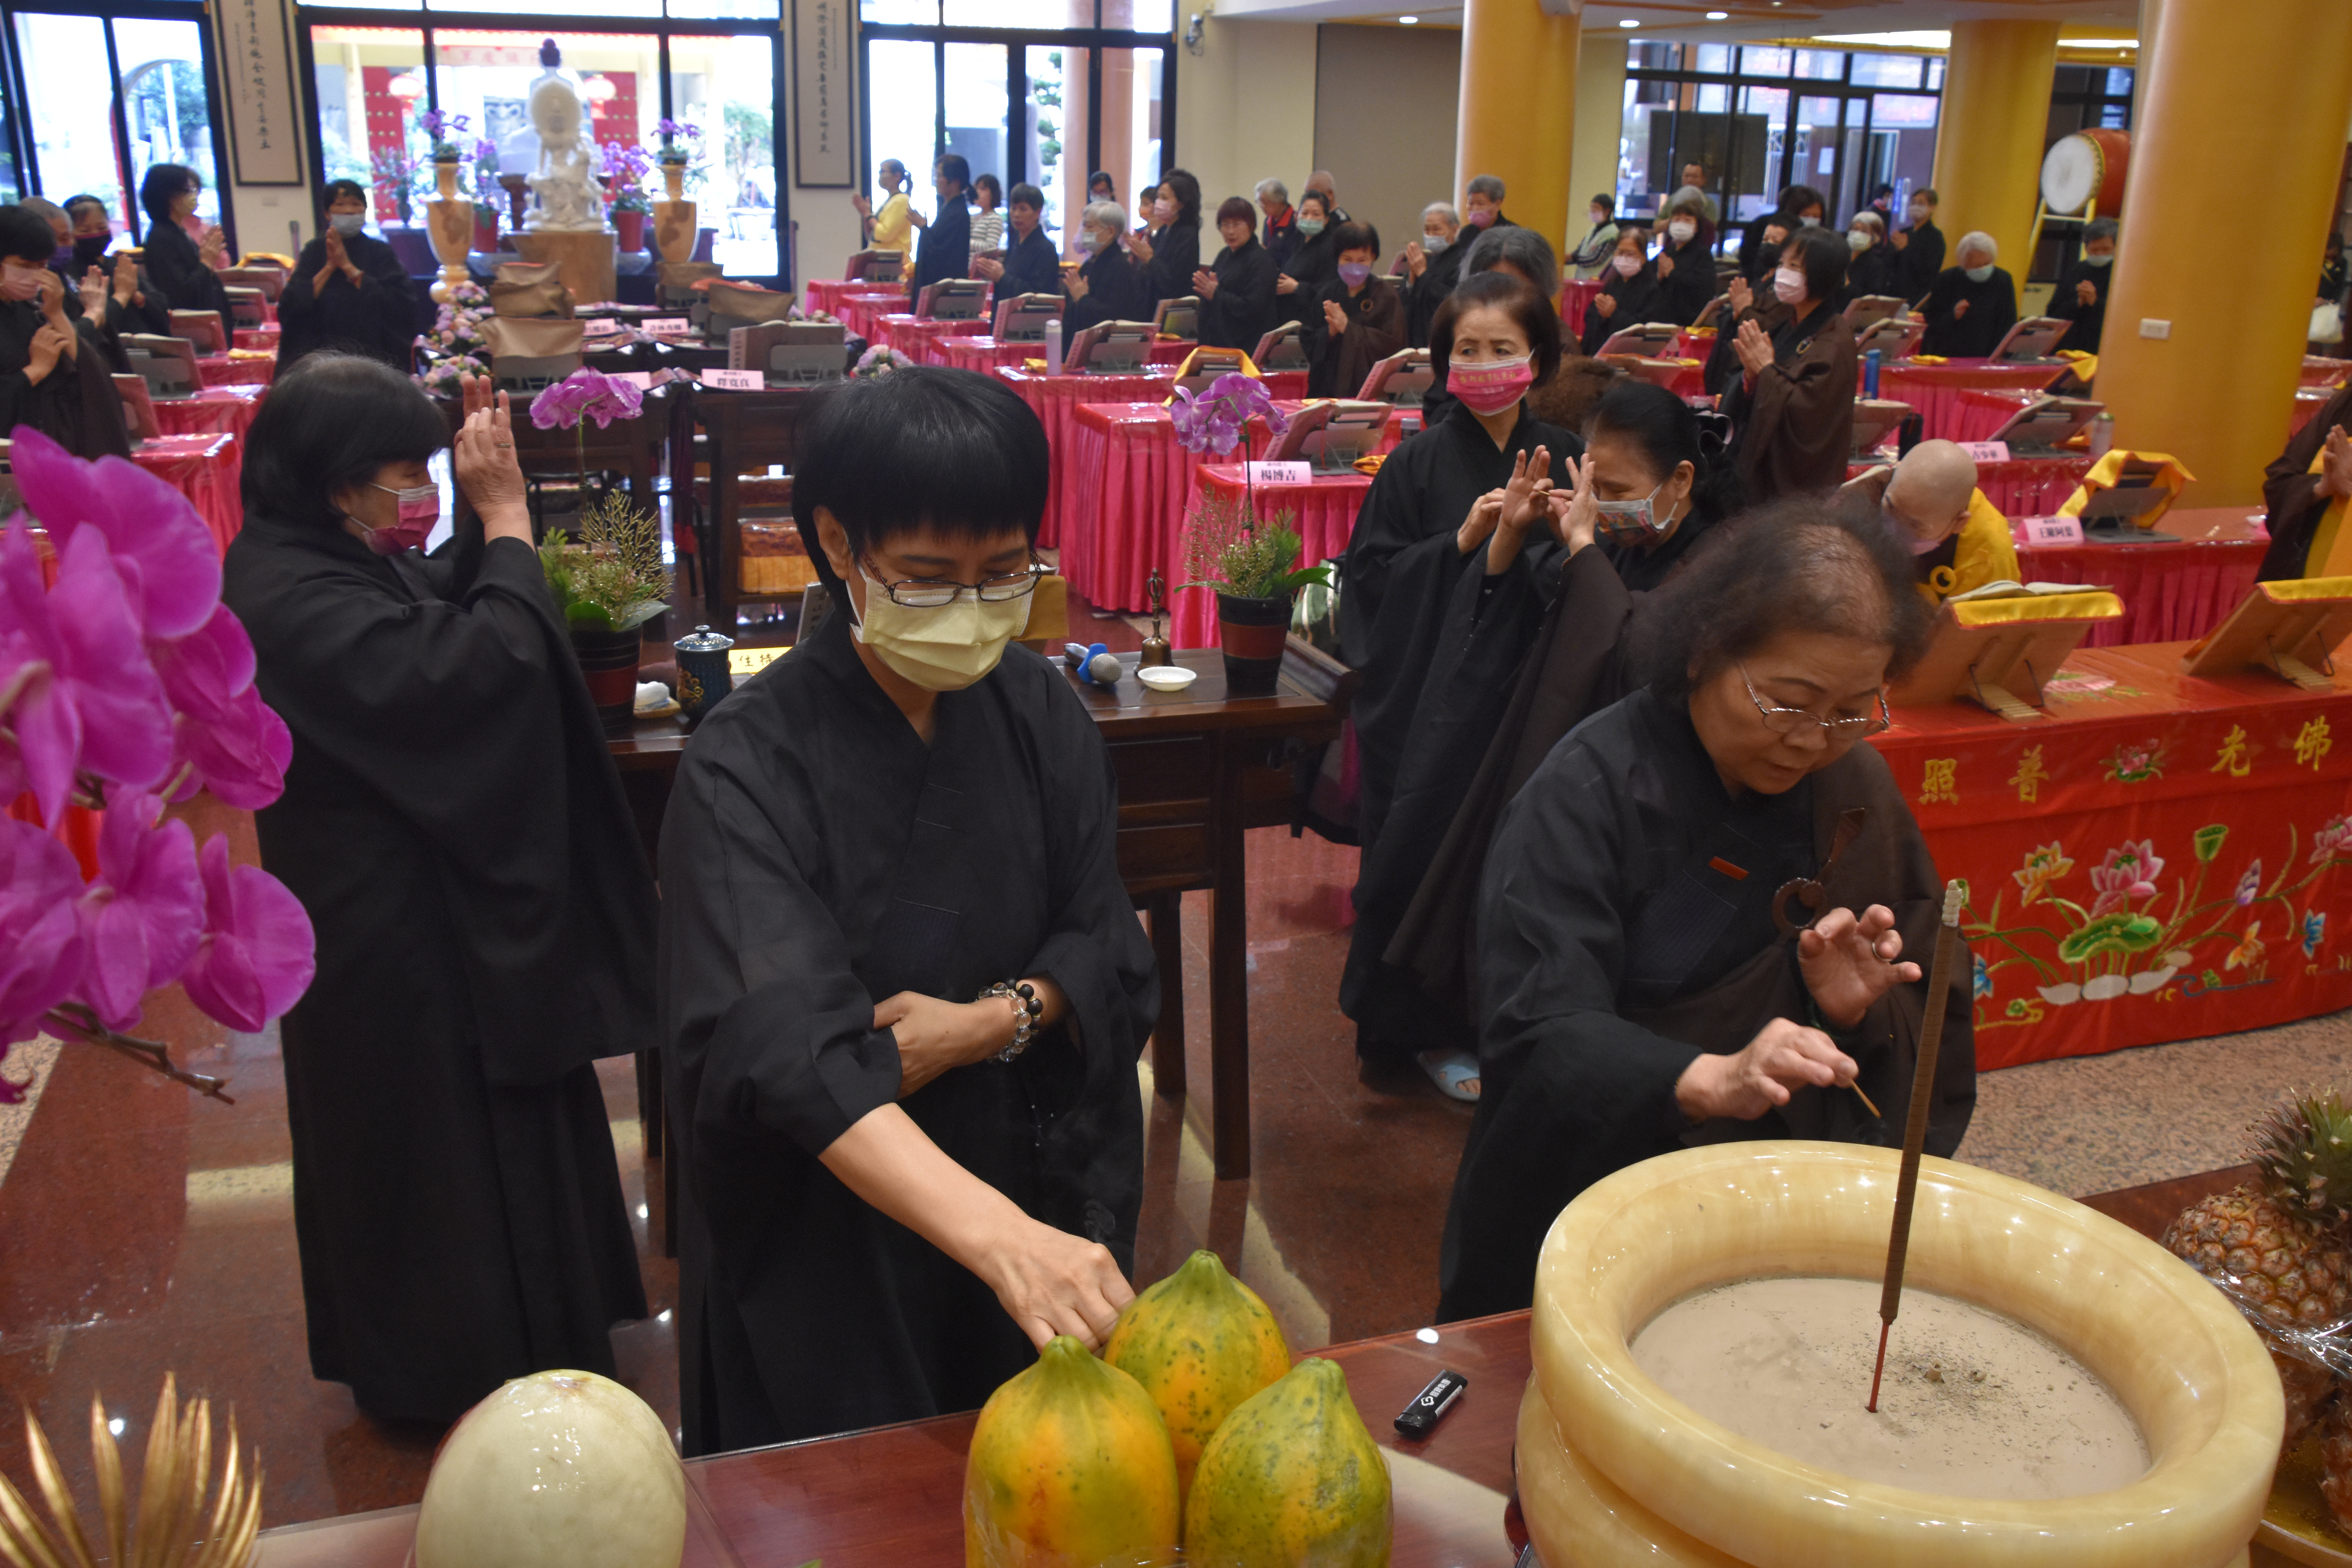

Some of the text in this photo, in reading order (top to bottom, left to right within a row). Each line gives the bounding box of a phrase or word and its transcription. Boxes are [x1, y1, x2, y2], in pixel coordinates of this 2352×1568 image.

[1261, 469, 1296, 481] 楊博吉
[739, 652, 784, 667] 住持
